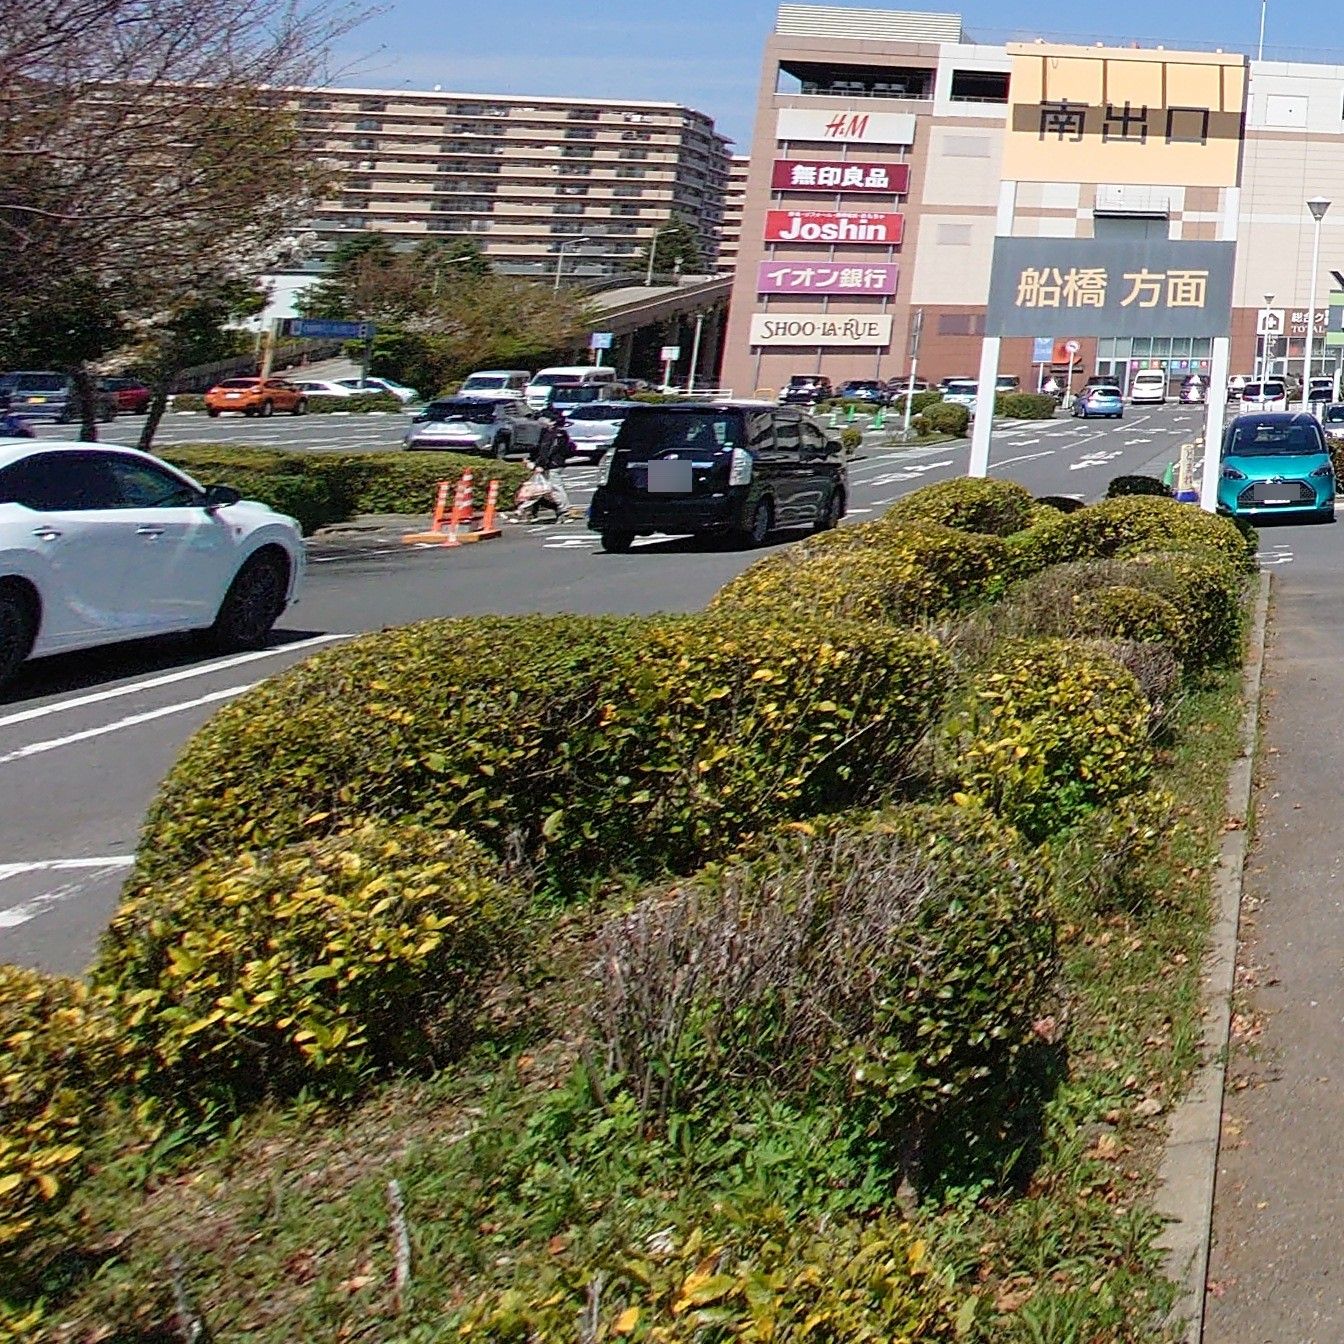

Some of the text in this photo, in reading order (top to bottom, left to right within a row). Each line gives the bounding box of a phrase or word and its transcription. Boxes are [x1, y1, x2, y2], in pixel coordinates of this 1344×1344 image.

[824, 113, 869, 139] H&M
[1038, 97, 1210, 146] 南出口
[790, 164, 890, 189] 無印良品
[779, 218, 887, 241] Joshin
[767, 267, 888, 290] イオン銀行
[1015, 267, 1209, 308] 船橋 方面
[761, 319, 880, 340] SHOO-LA-RUE
